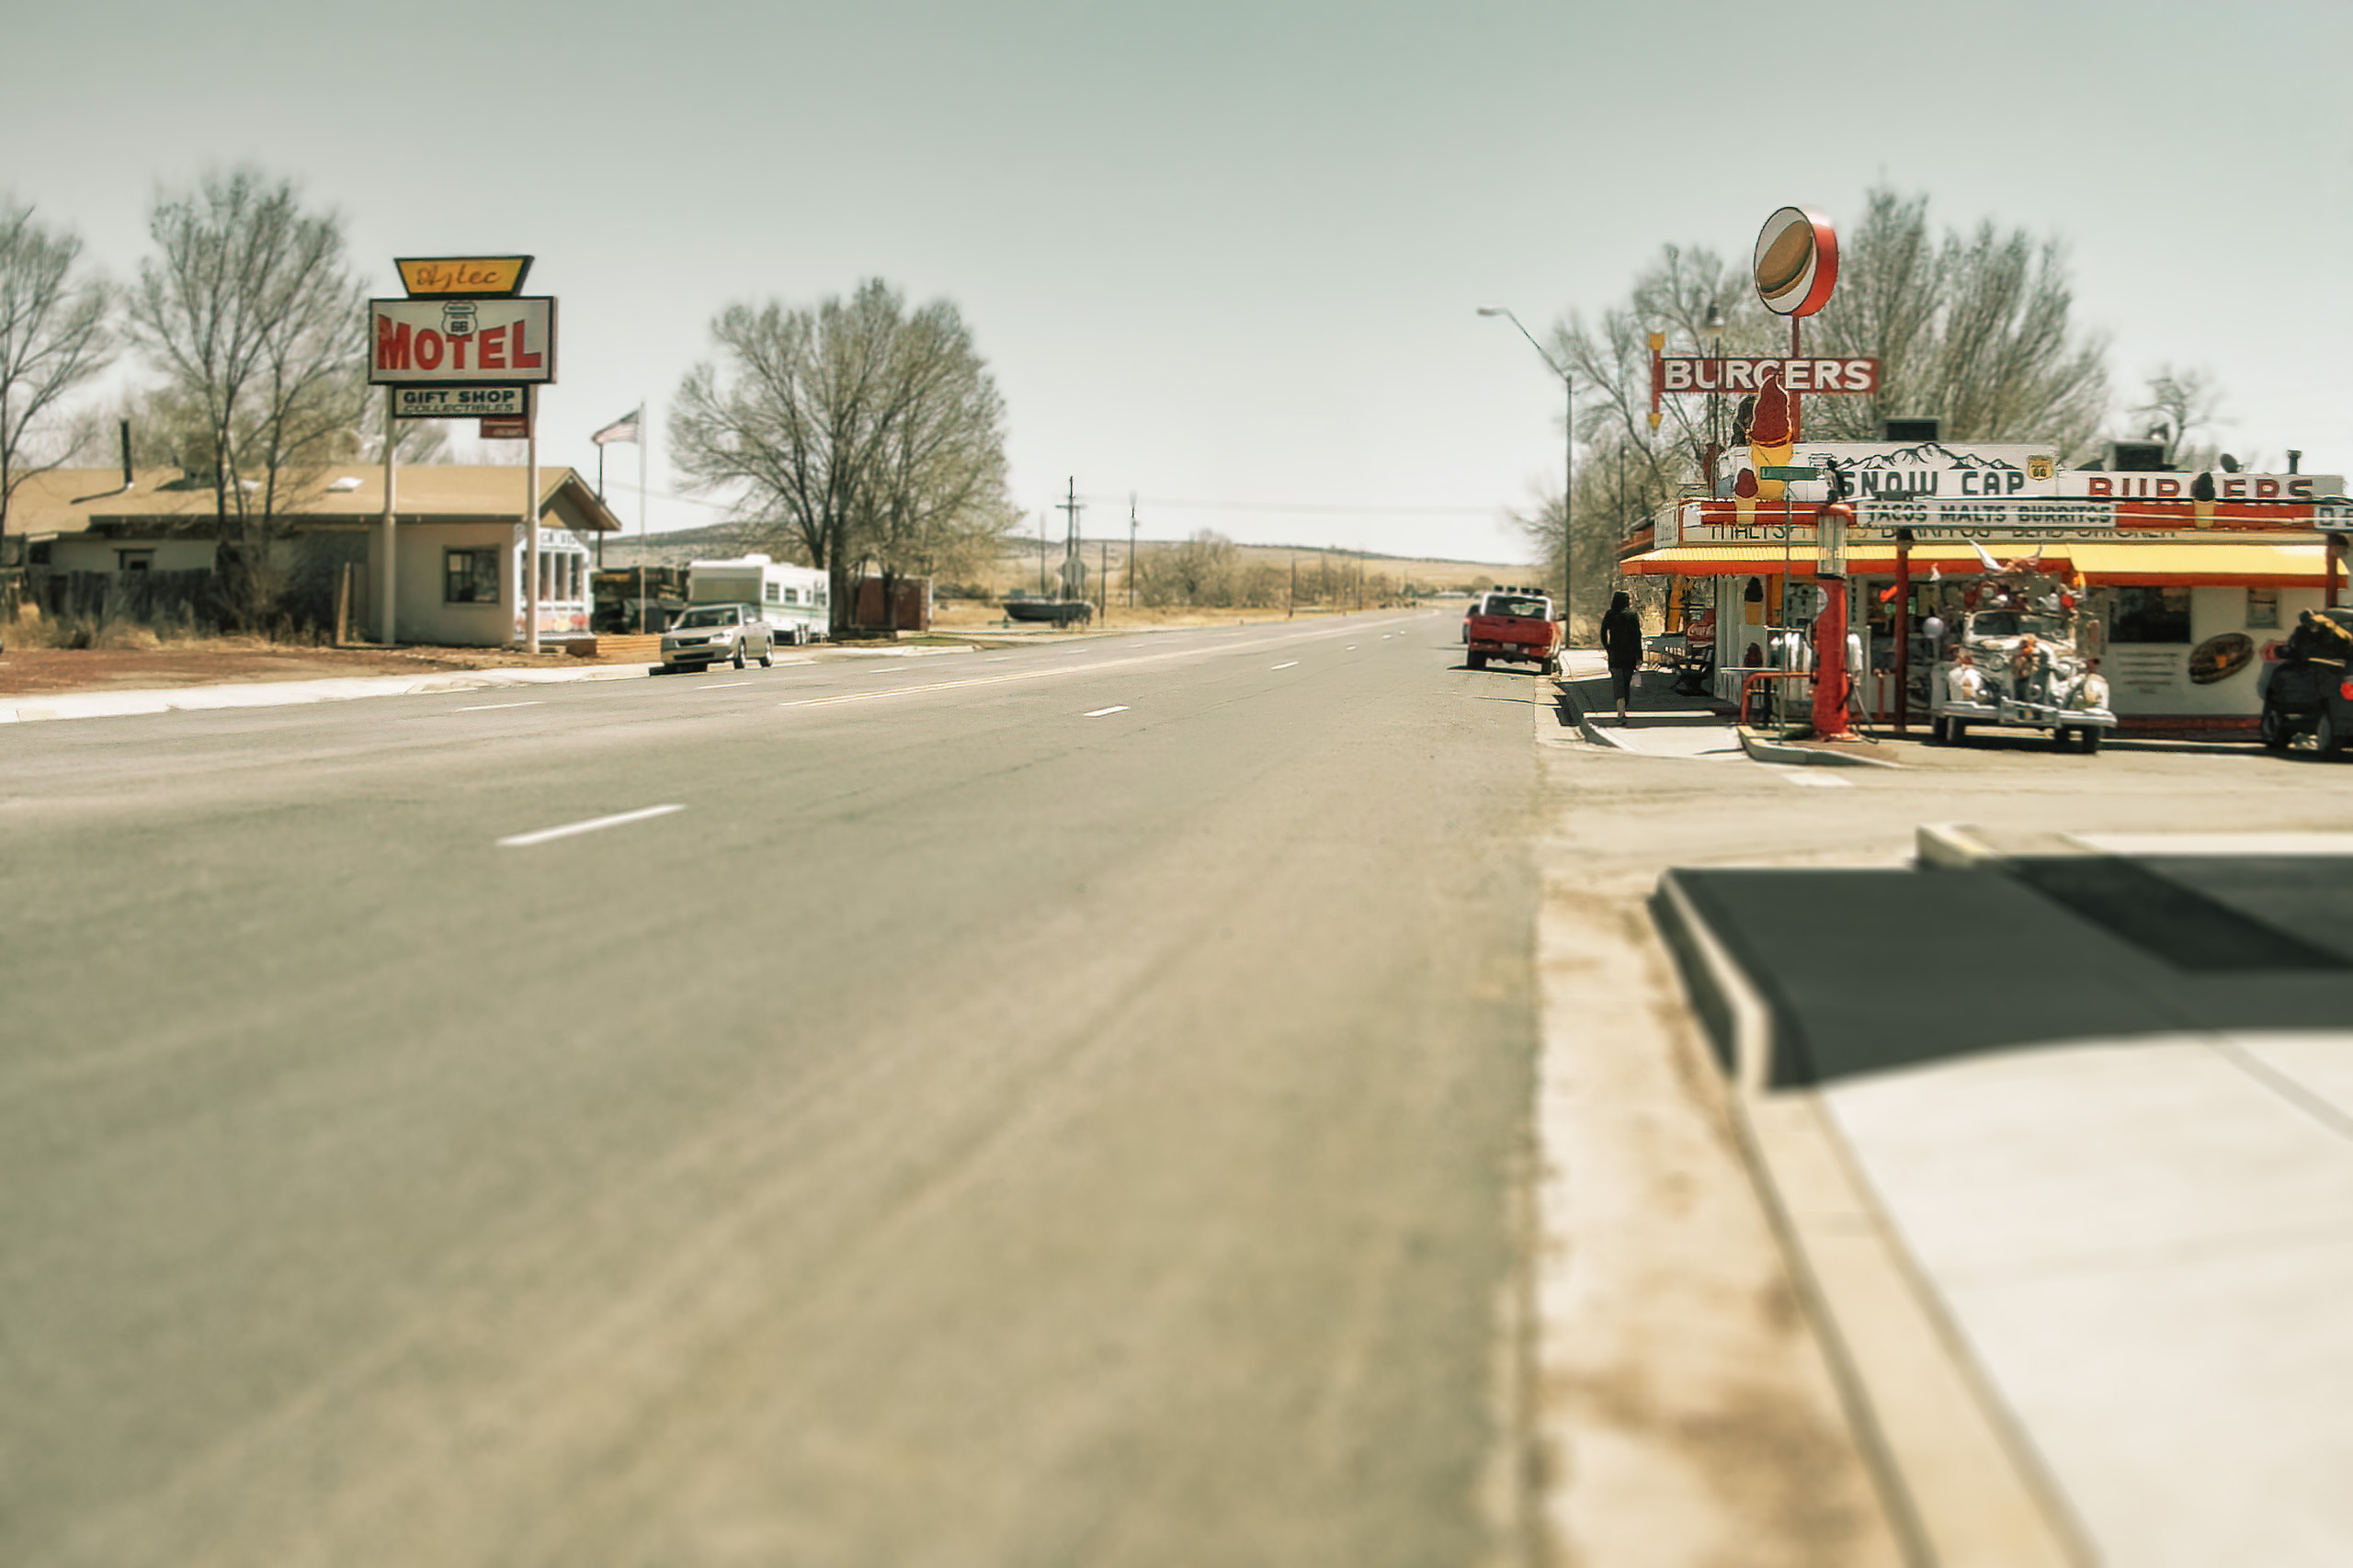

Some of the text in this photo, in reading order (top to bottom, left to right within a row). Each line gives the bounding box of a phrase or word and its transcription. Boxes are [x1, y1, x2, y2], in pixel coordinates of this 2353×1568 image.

[377, 313, 542, 370] MOTEL
[403, 390, 515, 403] GIFT SHOP
[1961, 471, 2025, 496] CAP
[1866, 504, 2111, 524] TACOS MALTS BURRITOS
